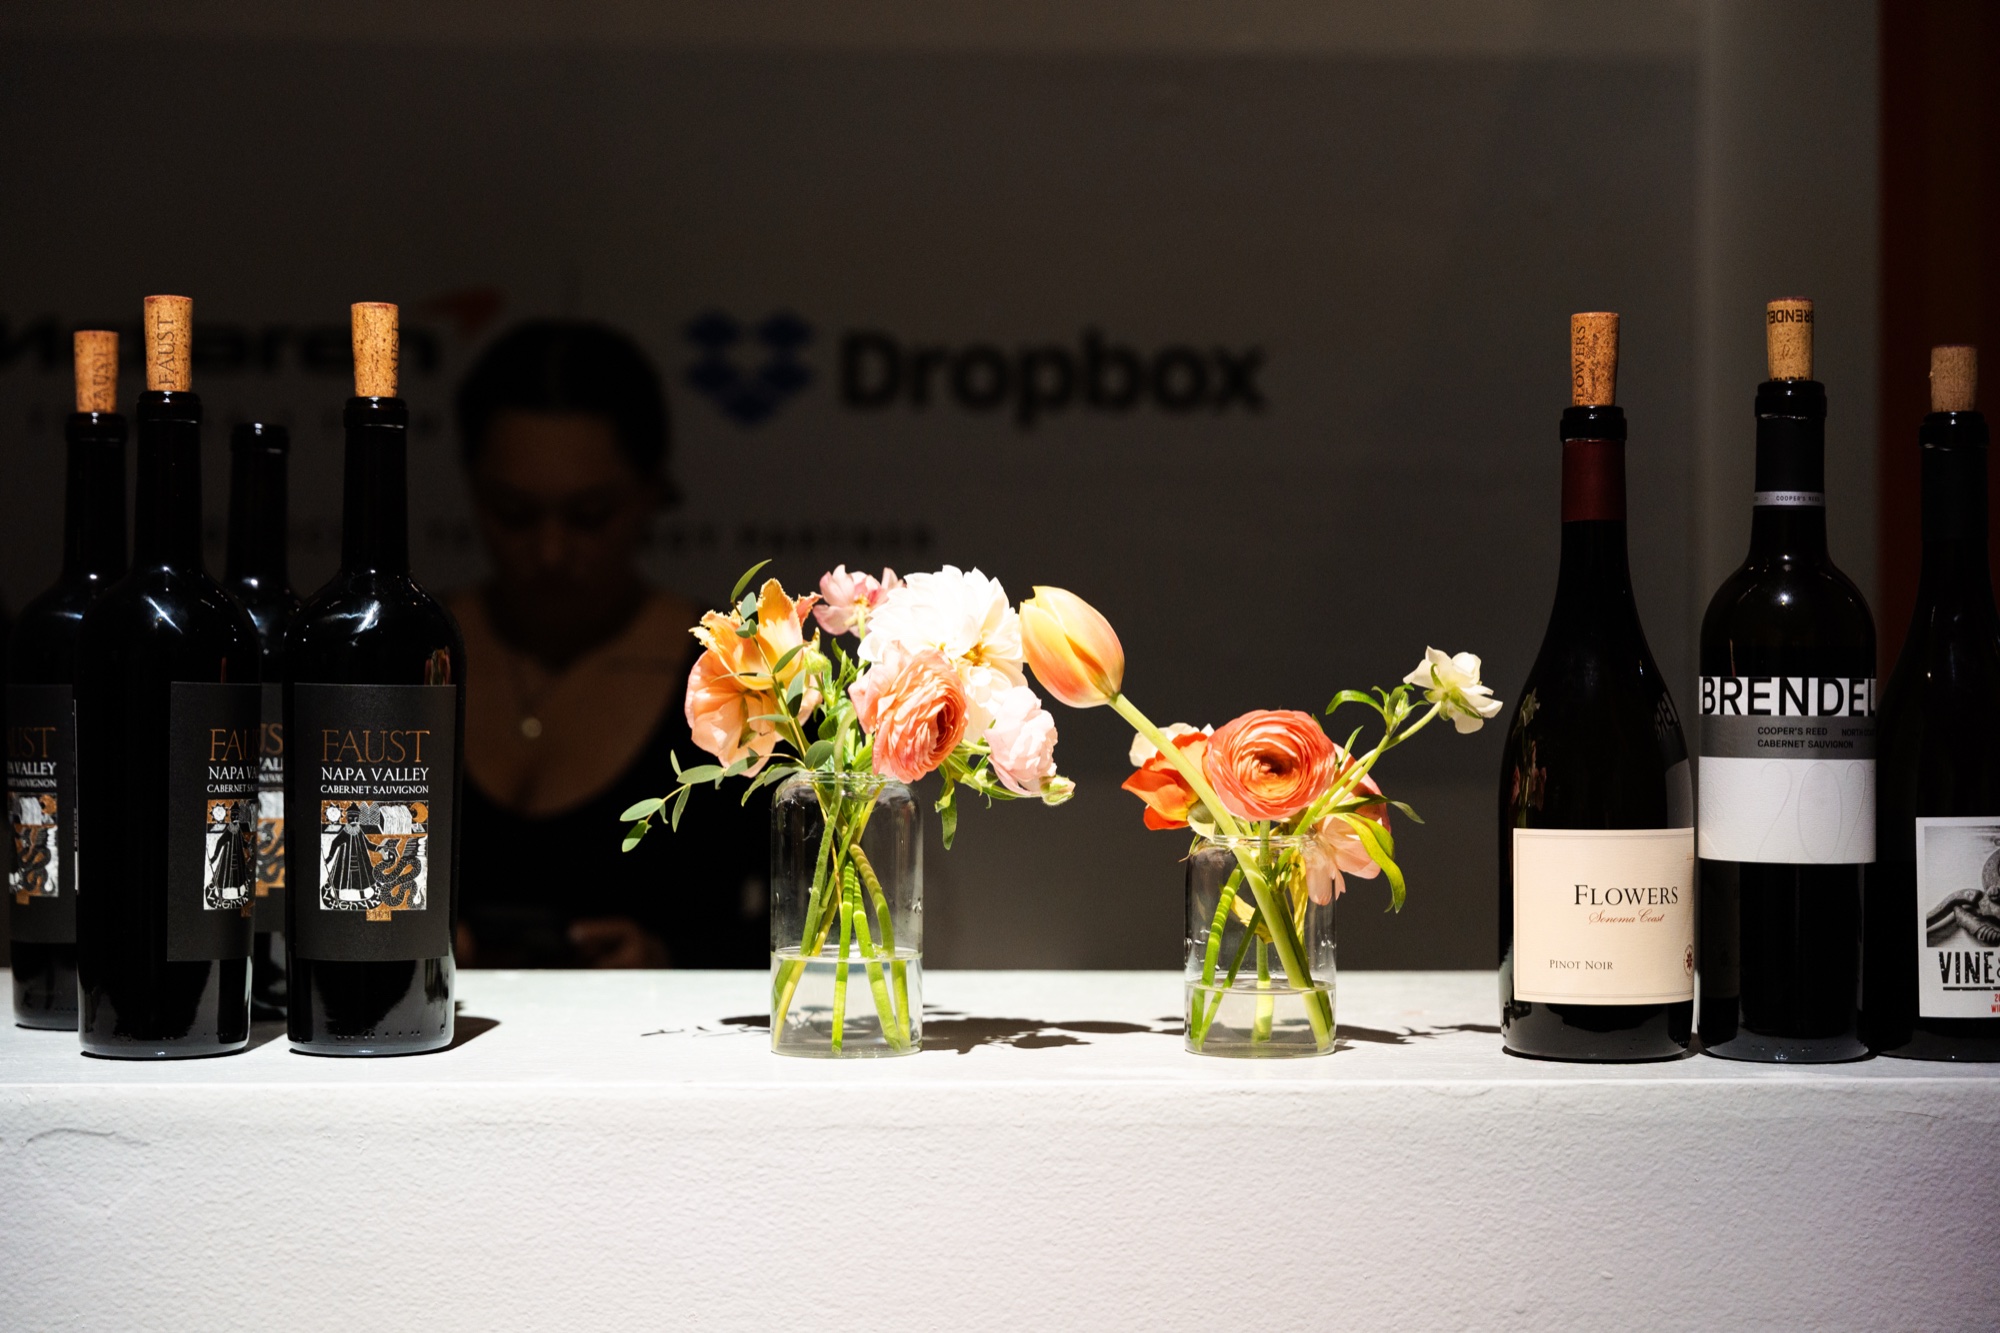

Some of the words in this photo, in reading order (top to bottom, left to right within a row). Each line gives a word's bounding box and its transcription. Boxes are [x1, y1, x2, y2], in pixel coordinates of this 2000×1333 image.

[156, 313, 175, 387] FAUST
[841, 327, 1265, 430] Dropbox
[1702, 676, 1876, 717] BRENDEL
[1757, 726, 1804, 736] COOPER'S
[1806, 727, 1828, 736] REED
[321, 729, 431, 763] FAUST
[1757, 740, 1805, 749] CABERNET
[1808, 740, 1854, 749] SAUVIGNON
[14, 761, 57, 776] VALLEY
[208, 766, 245, 780] NAPA
[321, 766, 367, 782] NAPA
[370, 767, 430, 782] VALLEY
[206, 784, 246, 793] CABERNET
[320, 784, 372, 794] CABERNET
[372, 785, 429, 795] SAUVIGNON
[1574, 884, 1679, 906] FLOWERS
[1588, 909, 1636, 924] Sonoma
[1637, 908, 1666, 923] Coast
[1549, 959, 1582, 970] PINOT
[1585, 960, 1614, 970] NOIR
